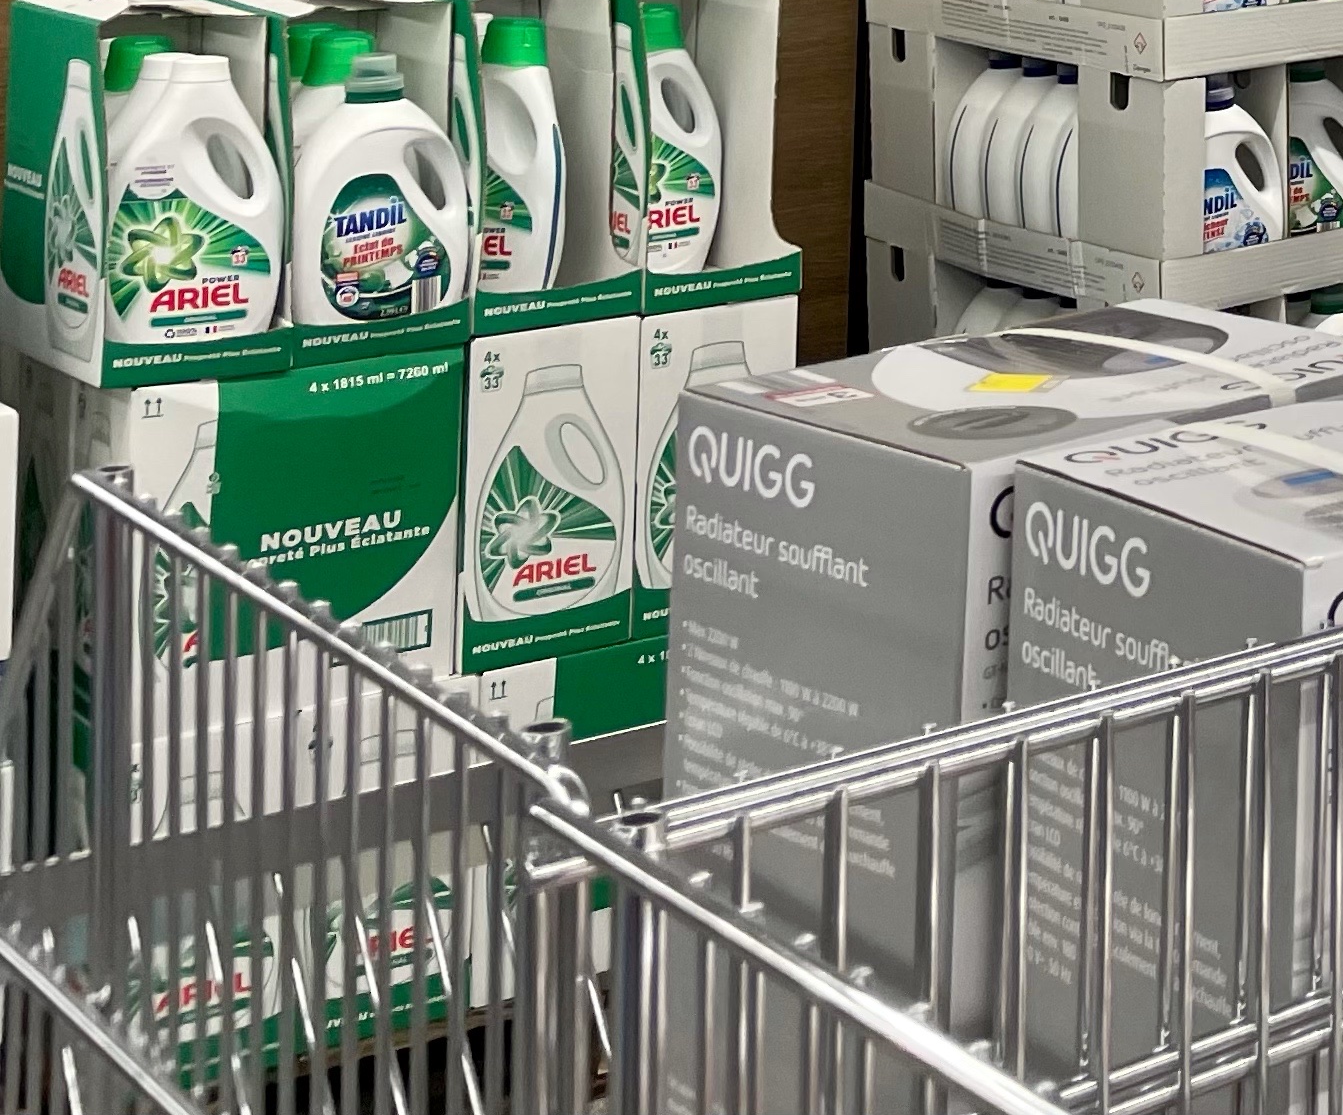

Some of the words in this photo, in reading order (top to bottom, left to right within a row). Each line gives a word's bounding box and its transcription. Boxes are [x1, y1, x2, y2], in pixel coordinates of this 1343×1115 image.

[333, 196, 408, 238] TANDIL
[1203, 187, 1238, 217] NDIL
[201, 275, 240, 285] POWER
[654, 280, 712, 297] NOUVEAU
[150, 283, 249, 312] ARIEL
[483, 300, 546, 318] NOUVEAU
[302, 331, 370, 349] NOUVEAU
[112, 352, 183, 369] NOUVEAU
[484, 351, 501, 364] 4x
[309, 382, 318, 394] 4
[321, 383, 330, 392] x
[333, 375, 365, 390] 1815
[366, 372, 384, 386] ml
[398, 365, 430, 381] 7260
[432, 362, 449, 377] ml
[688, 426, 816, 509] QUIGG
[260, 510, 403, 553] NOUVEAU
[309, 541, 346, 558] Plus
[351, 522, 431, 550] Éclatante
[685, 505, 775, 560] Radiateur
[778, 538, 869, 588] soufflant
[1025, 501, 1151, 598] QUIGG
[513, 552, 597, 587] ARIEL
[683, 553, 761, 600] oscillant
[1023, 587, 1113, 649] Radiateur
[471, 635, 534, 655] NOUVEAU
[1021, 639, 1098, 690] oscillant
